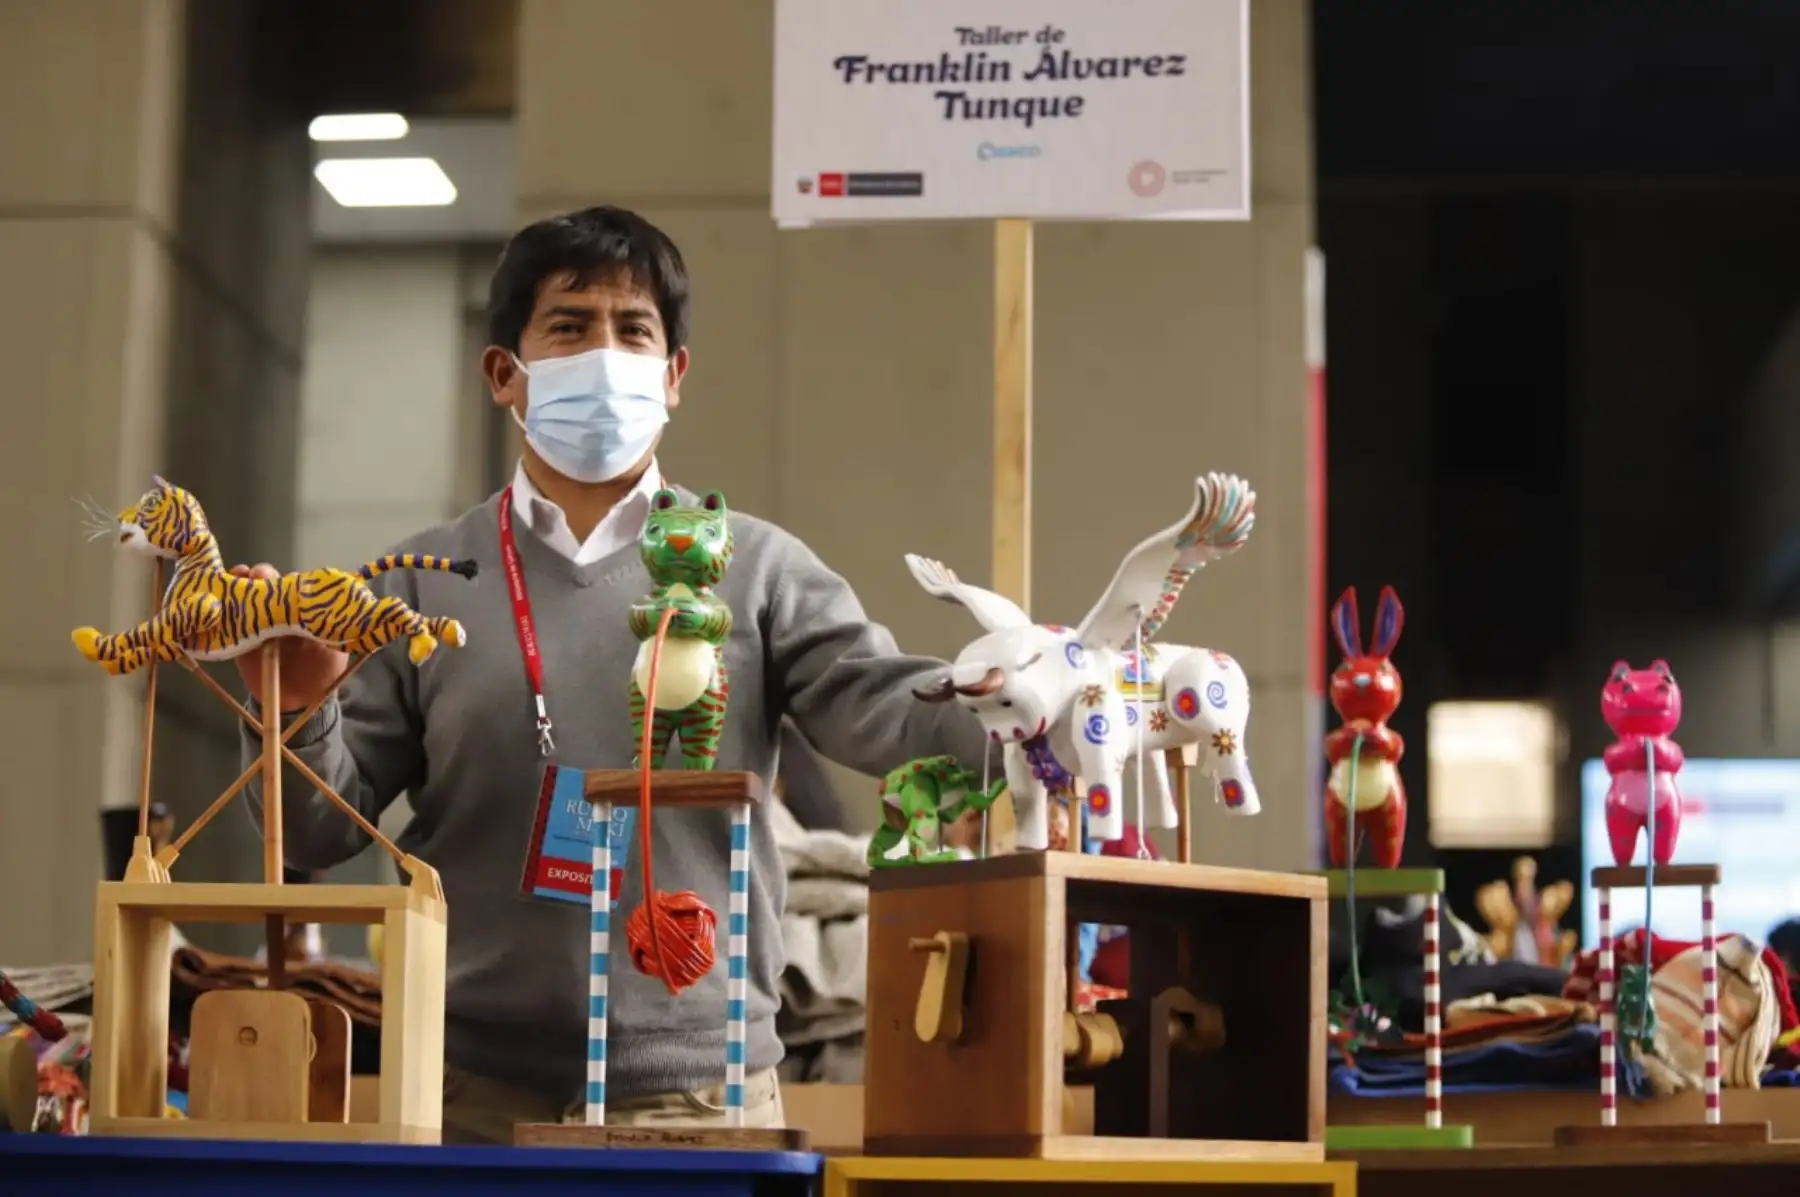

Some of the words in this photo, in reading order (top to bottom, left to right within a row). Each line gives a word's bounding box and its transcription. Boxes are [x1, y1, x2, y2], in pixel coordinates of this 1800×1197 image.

[954, 26, 1029, 45] Taller
[1036, 25, 1065, 44] de
[833, 52, 1011, 84] Franklin
[1023, 44, 1187, 81] Álvarez
[935, 90, 1085, 128] Tunque
[576, 816, 625, 837] MKI
[547, 867, 593, 885] EXPOSIT
